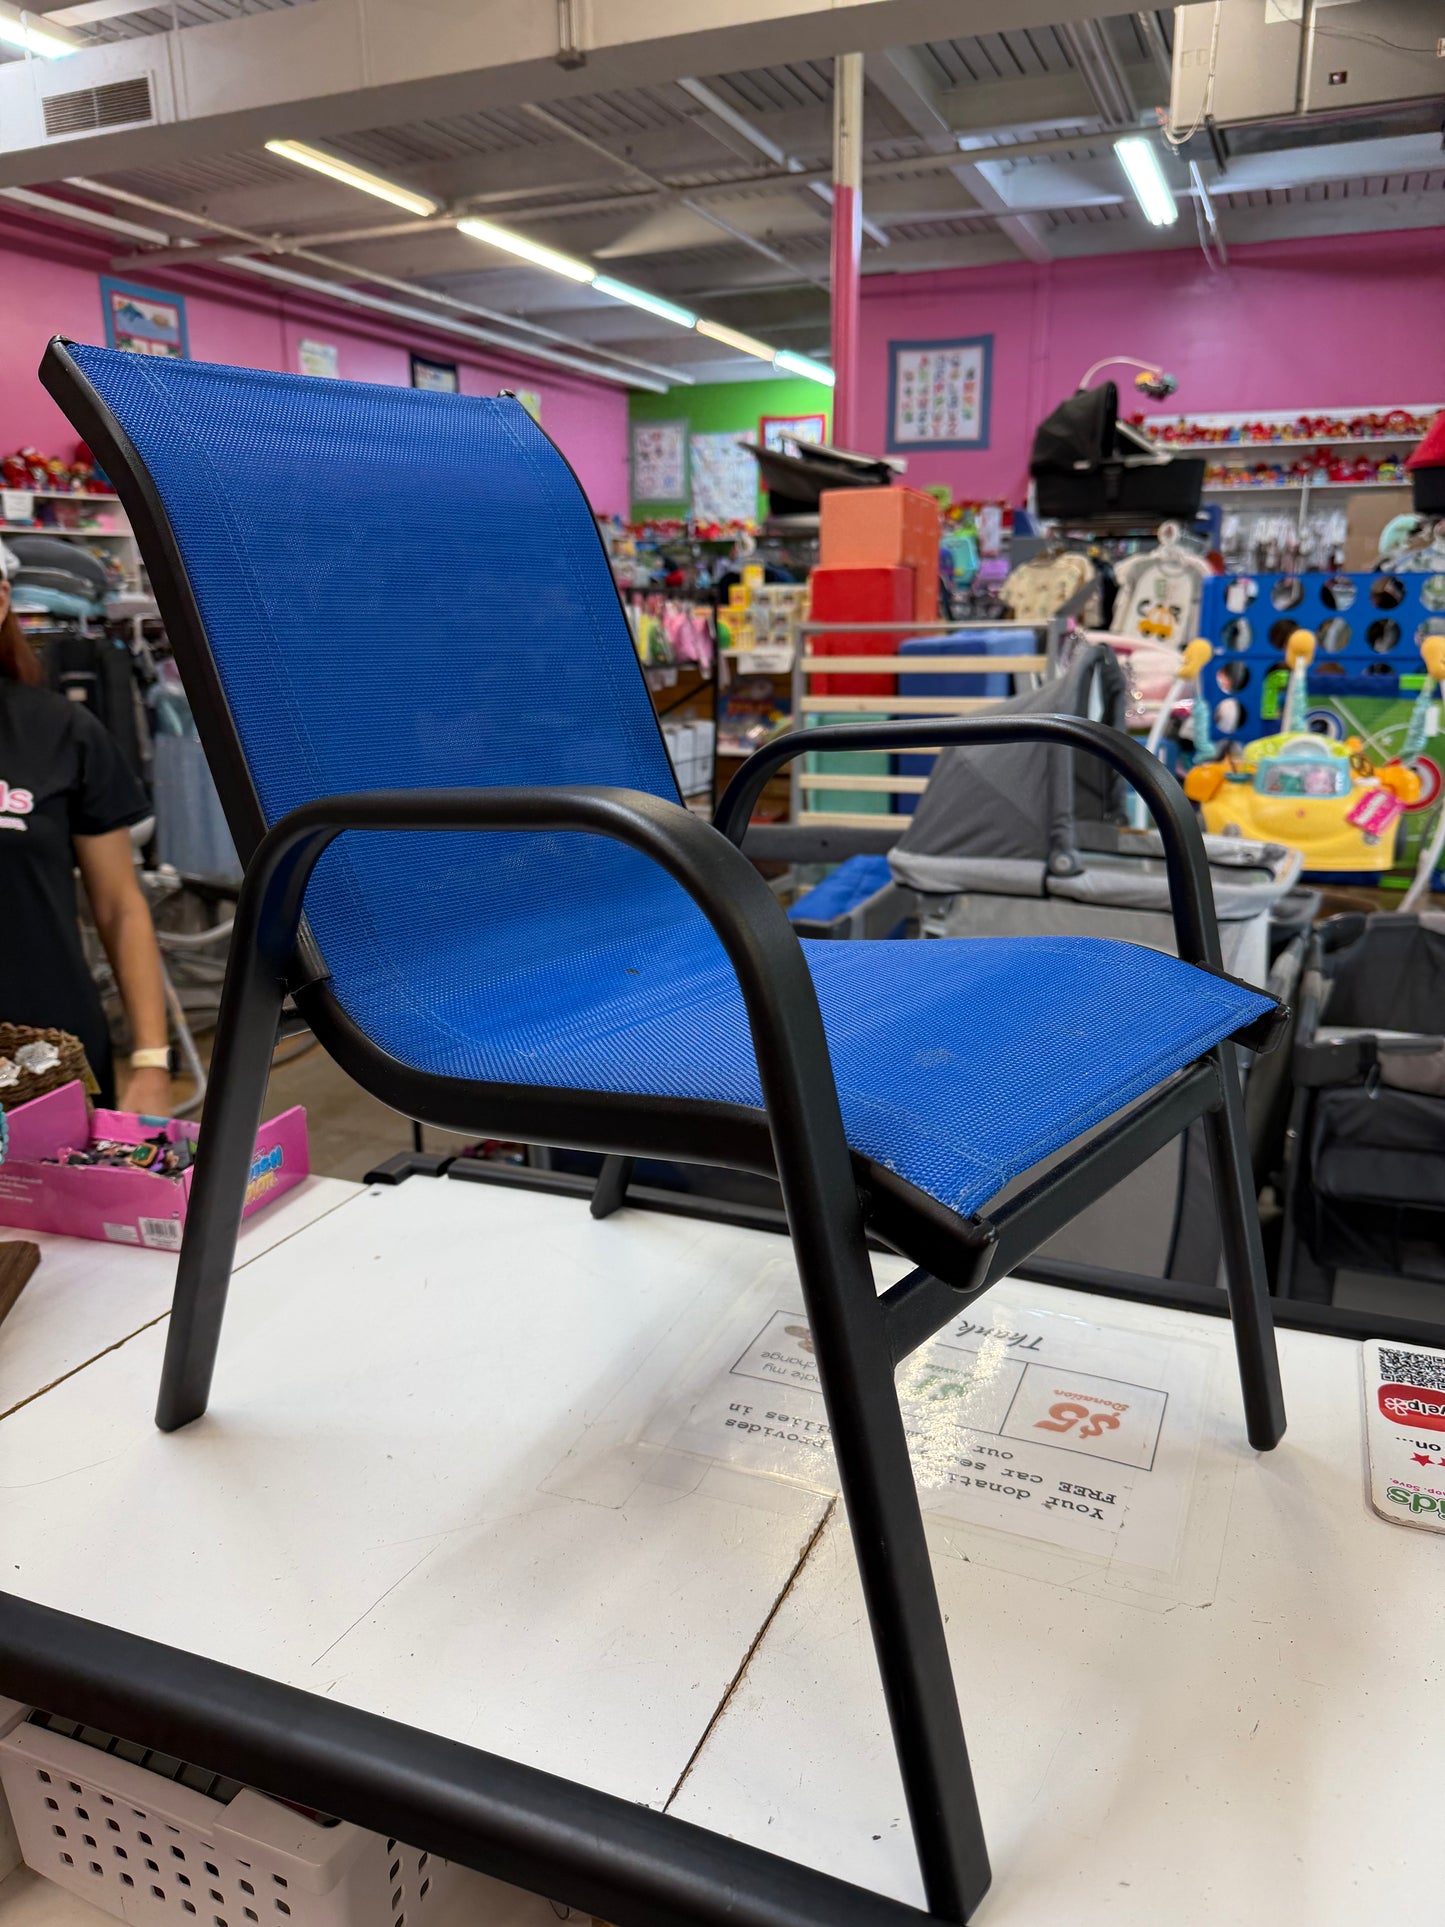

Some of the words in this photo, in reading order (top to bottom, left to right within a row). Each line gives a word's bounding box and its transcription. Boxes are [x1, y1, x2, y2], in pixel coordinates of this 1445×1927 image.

[956, 1320, 1043, 1351] Thank
[760, 1351, 817, 1369] change
[762, 1362, 786, 1375] my
[729, 1403, 753, 1416] in
[1053, 1389, 1130, 1412] Donation
[765, 1411, 832, 1434] ilies
[1032, 1402, 1120, 1439] $5
[725, 1419, 828, 1449] provides
[1395, 1437, 1442, 1452] on...
[972, 1445, 1014, 1460] our
[946, 1472, 1031, 1499] donati
[1001, 1468, 1043, 1484] car
[1058, 1481, 1117, 1505] FREE
[1045, 1496, 1104, 1520] Your
